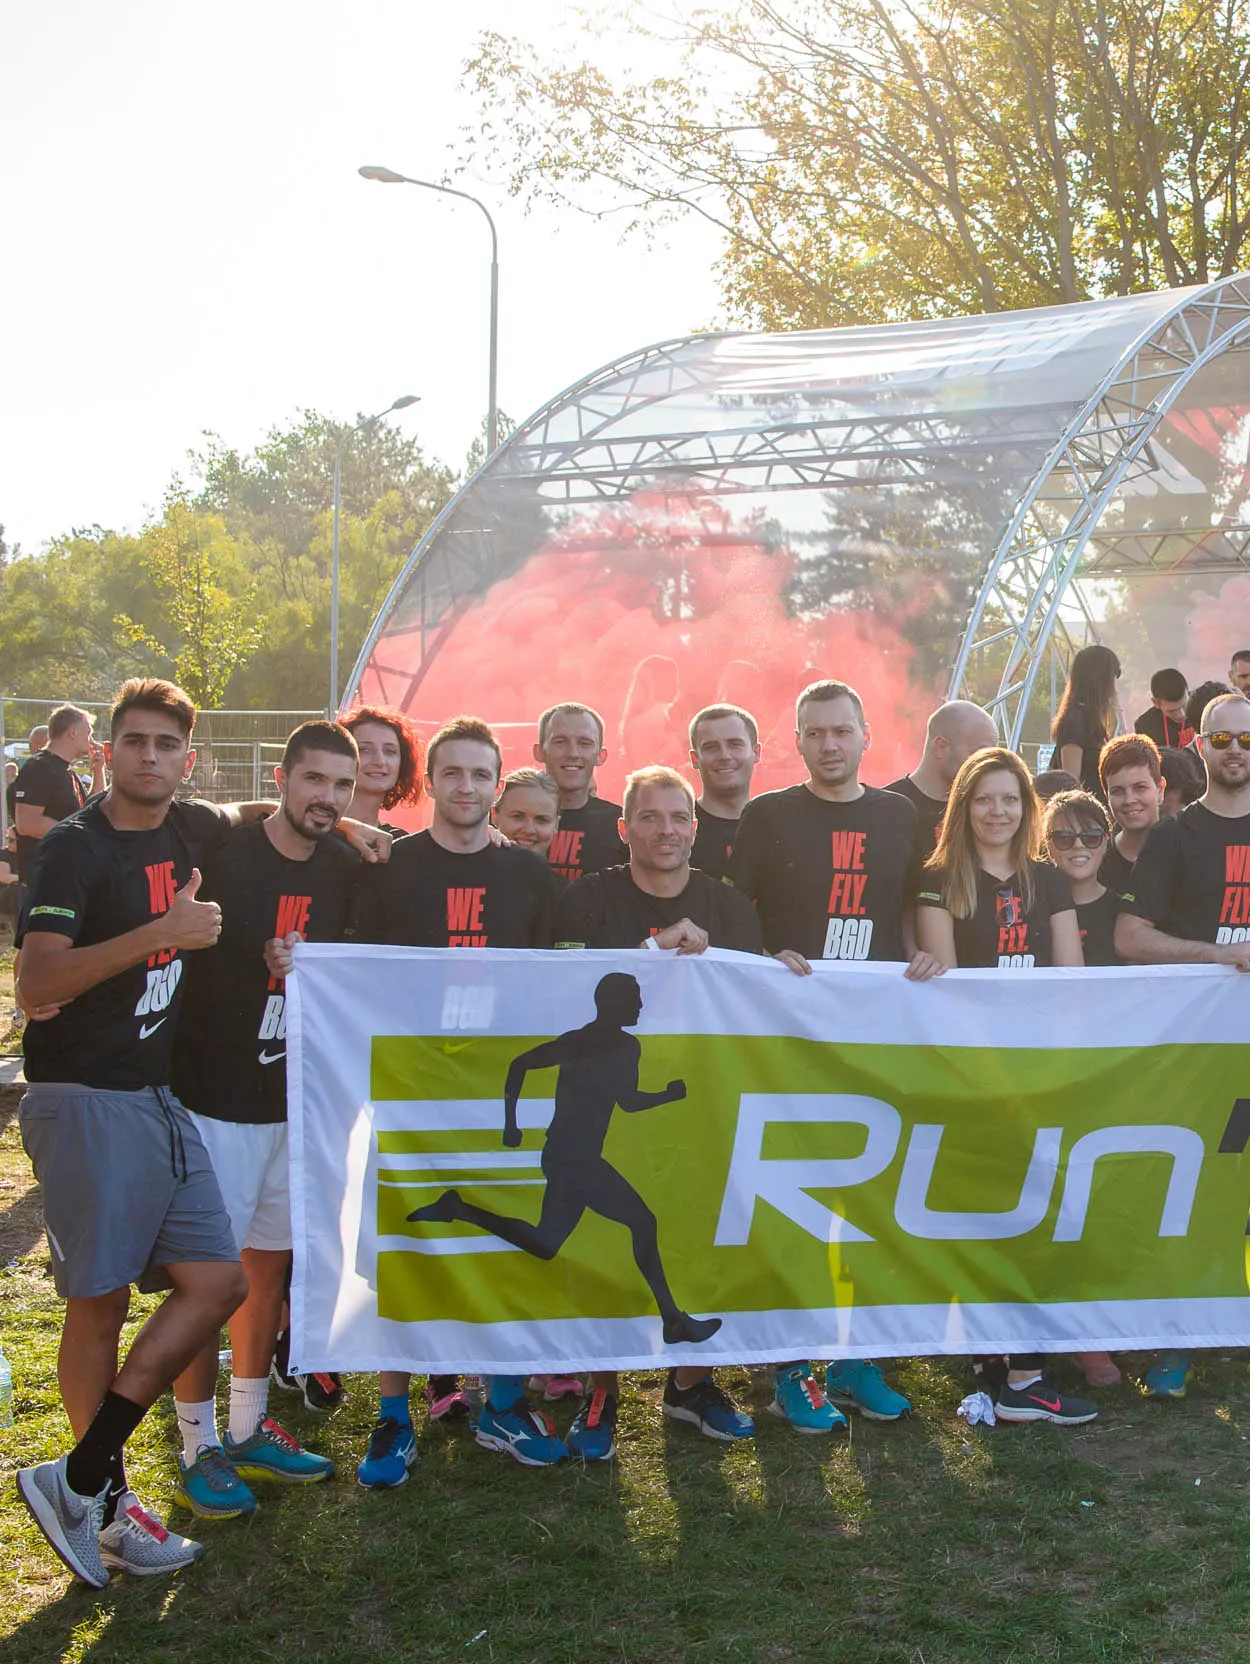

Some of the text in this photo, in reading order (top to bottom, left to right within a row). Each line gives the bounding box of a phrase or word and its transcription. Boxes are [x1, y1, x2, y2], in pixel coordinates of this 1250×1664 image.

[548, 831, 585, 866] WE
[831, 831, 867, 870] WE
[447, 887, 487, 931] WE
[827, 873, 869, 915] FLY.
[275, 895, 312, 941] WE
[822, 917, 874, 960] BGD
[997, 924, 1029, 953] FLY.
